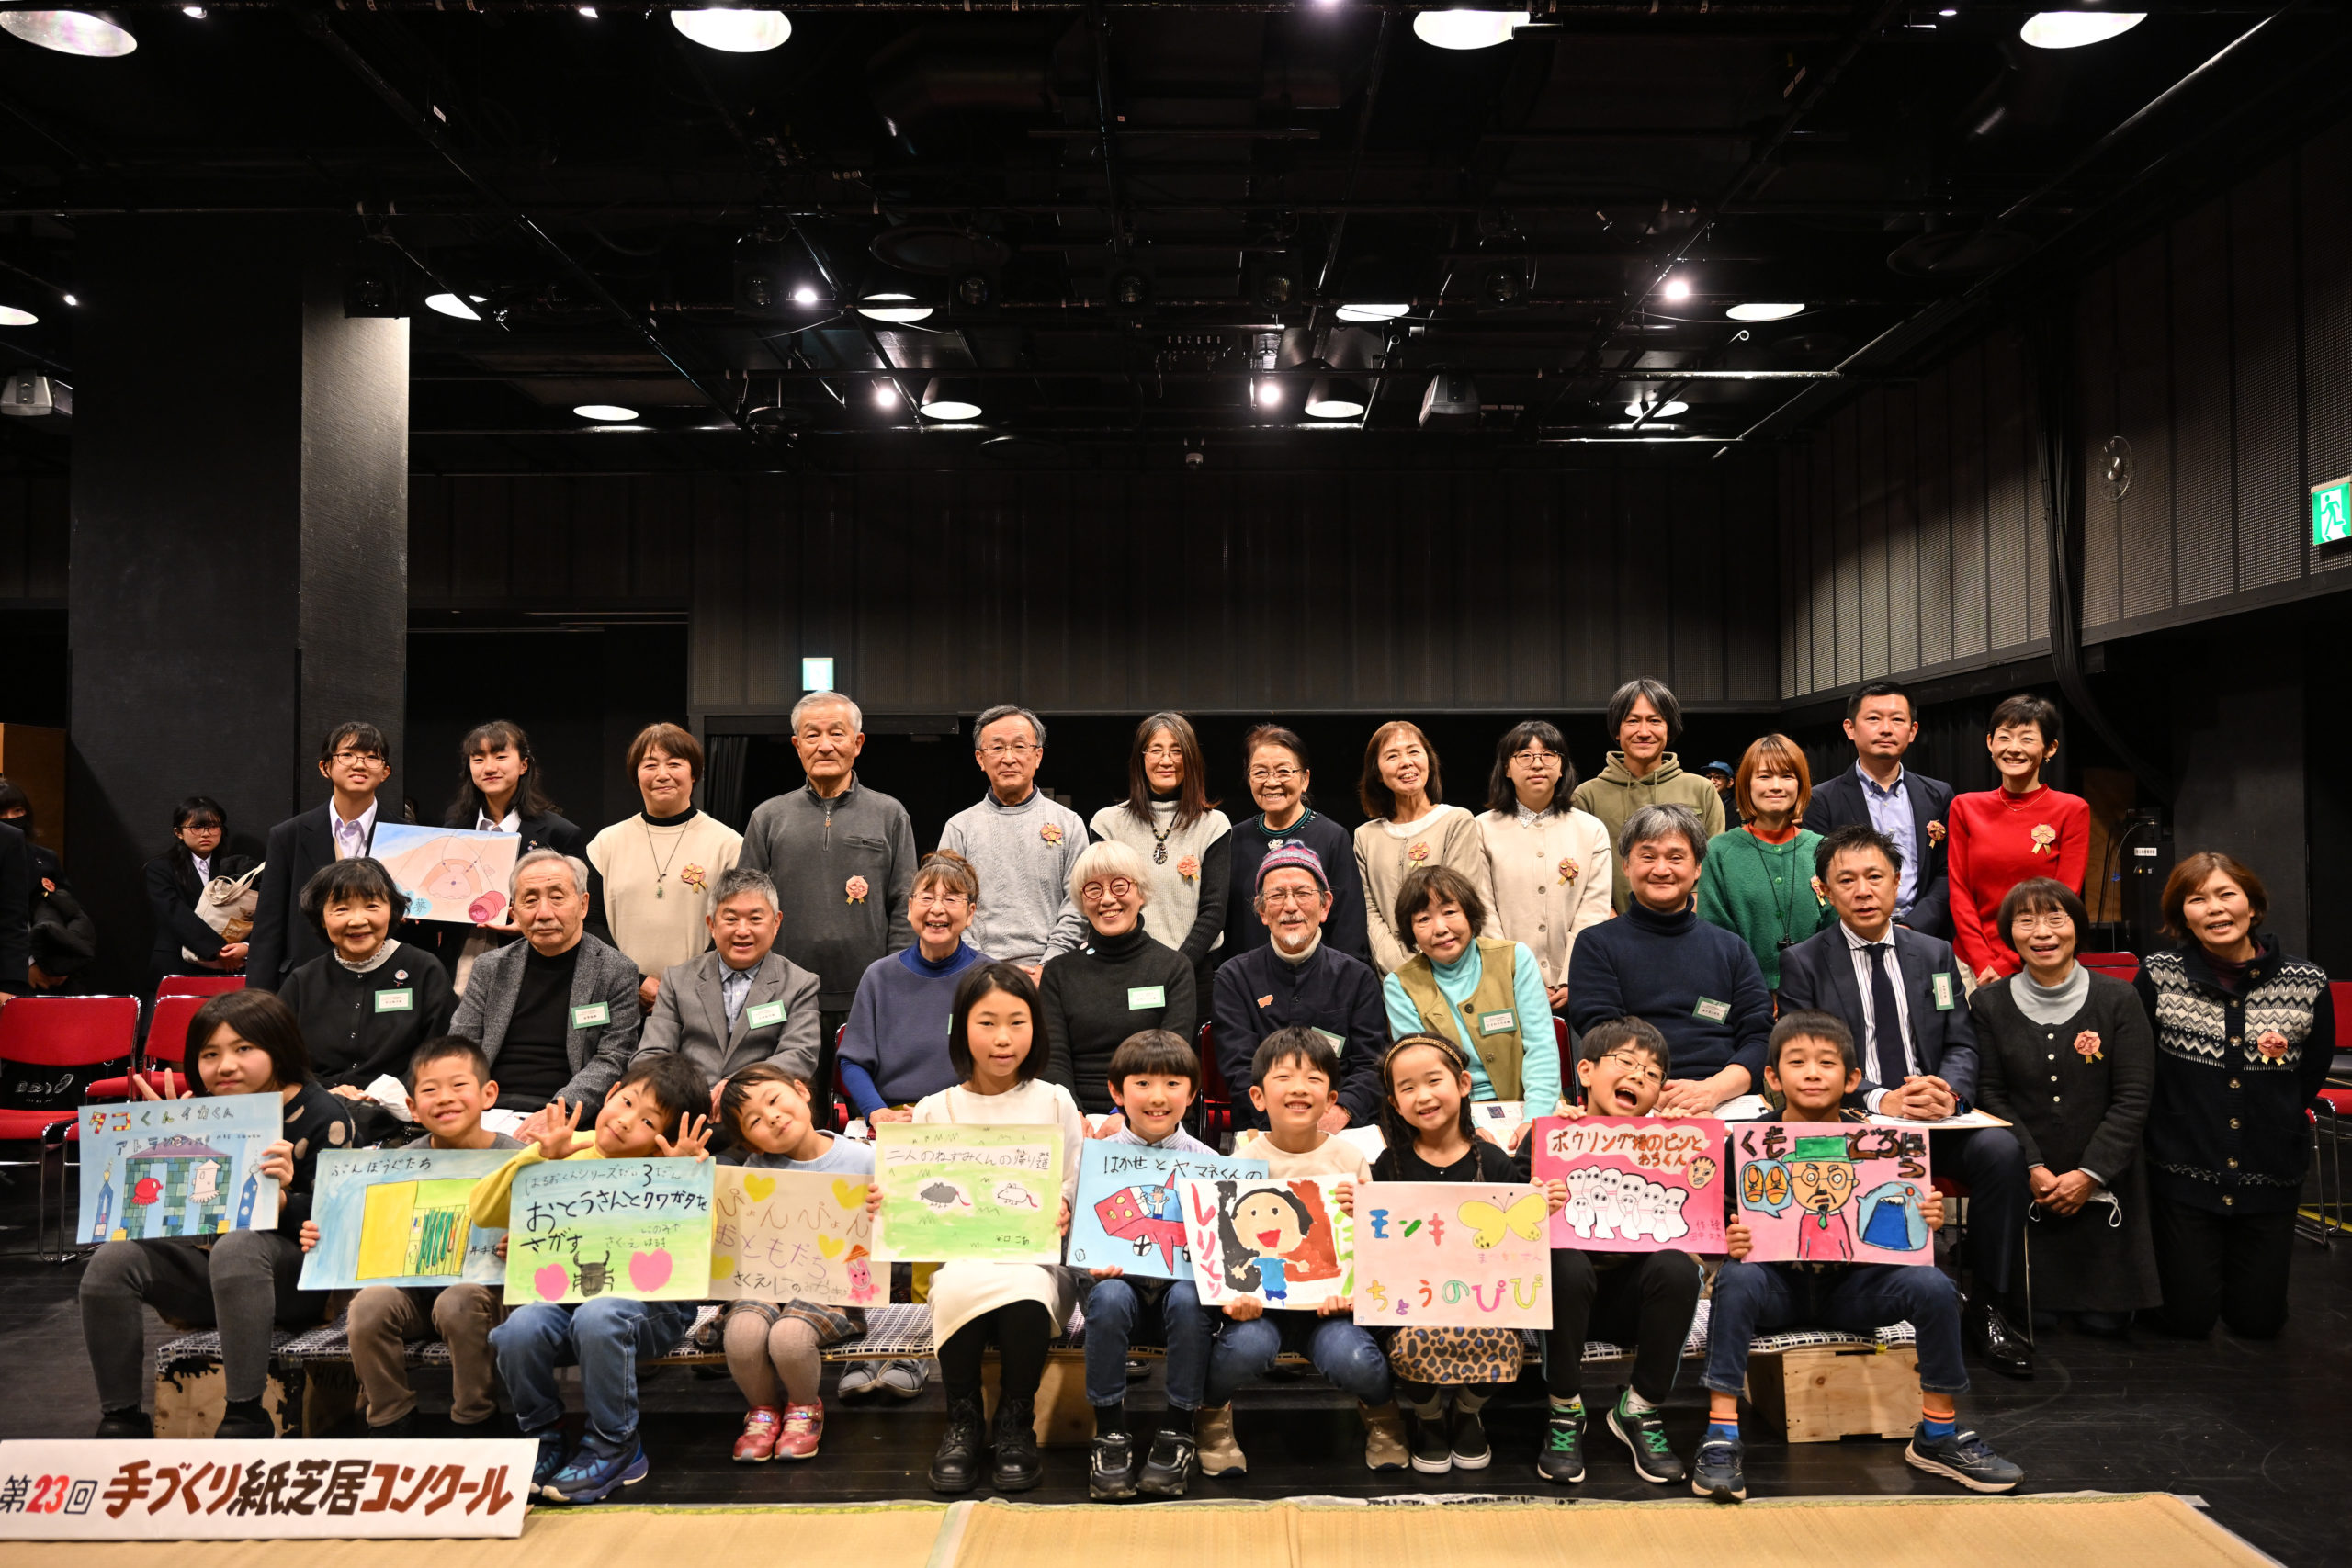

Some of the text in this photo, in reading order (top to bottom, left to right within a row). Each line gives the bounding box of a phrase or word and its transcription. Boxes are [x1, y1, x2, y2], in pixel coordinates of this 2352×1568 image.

[519, 1227, 582, 1253] さがす
[1191, 1183, 1223, 1298] しりとり
[1369, 1209, 1445, 1247] モンキ
[1366, 1274, 1543, 1315] ちょうのぴぴ
[0, 1458, 514, 1520] 第23回 手づくり紙芝居コンクール
